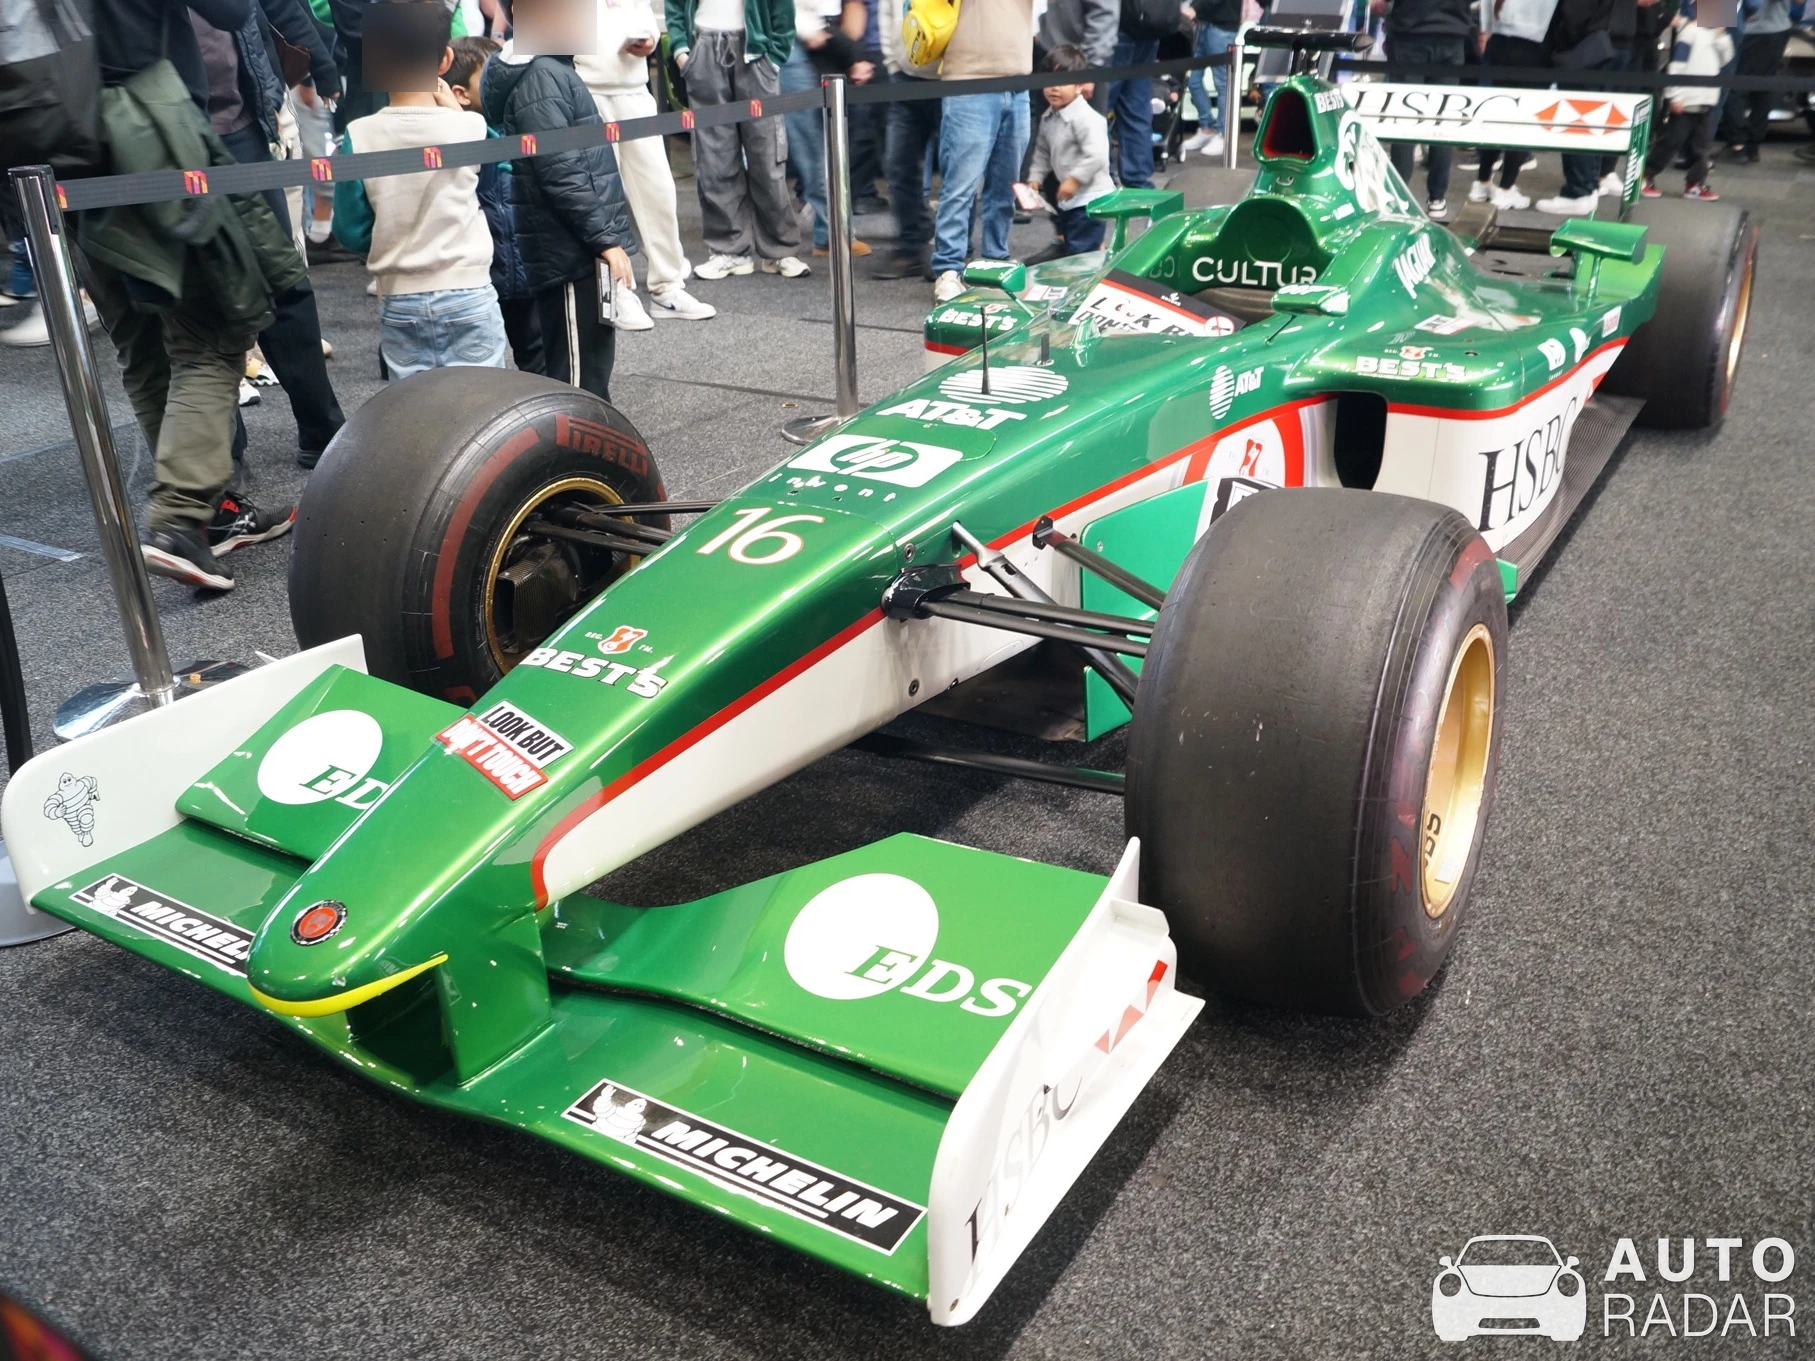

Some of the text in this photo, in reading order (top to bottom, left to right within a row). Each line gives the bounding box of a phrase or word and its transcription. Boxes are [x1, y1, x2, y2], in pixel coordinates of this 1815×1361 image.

[1354, 90, 1521, 128] HSBC
[1192, 256, 1317, 287] CULTUR
[1234, 366, 1265, 397] AT&T
[1356, 356, 1467, 381] BEST'S
[875, 398, 1027, 430] AT&T
[555, 413, 648, 476] PIRELLI
[1478, 395, 1578, 533] HSBC
[697, 507, 825, 565] 16
[480, 705, 565, 761] LOOK BUT
[299, 764, 391, 810] ED
[475, 741, 543, 795] TOUCH
[130, 900, 251, 960] MICHEL
[844, 945, 1033, 1017] EDS
[650, 1120, 900, 1229] MICHELIN
